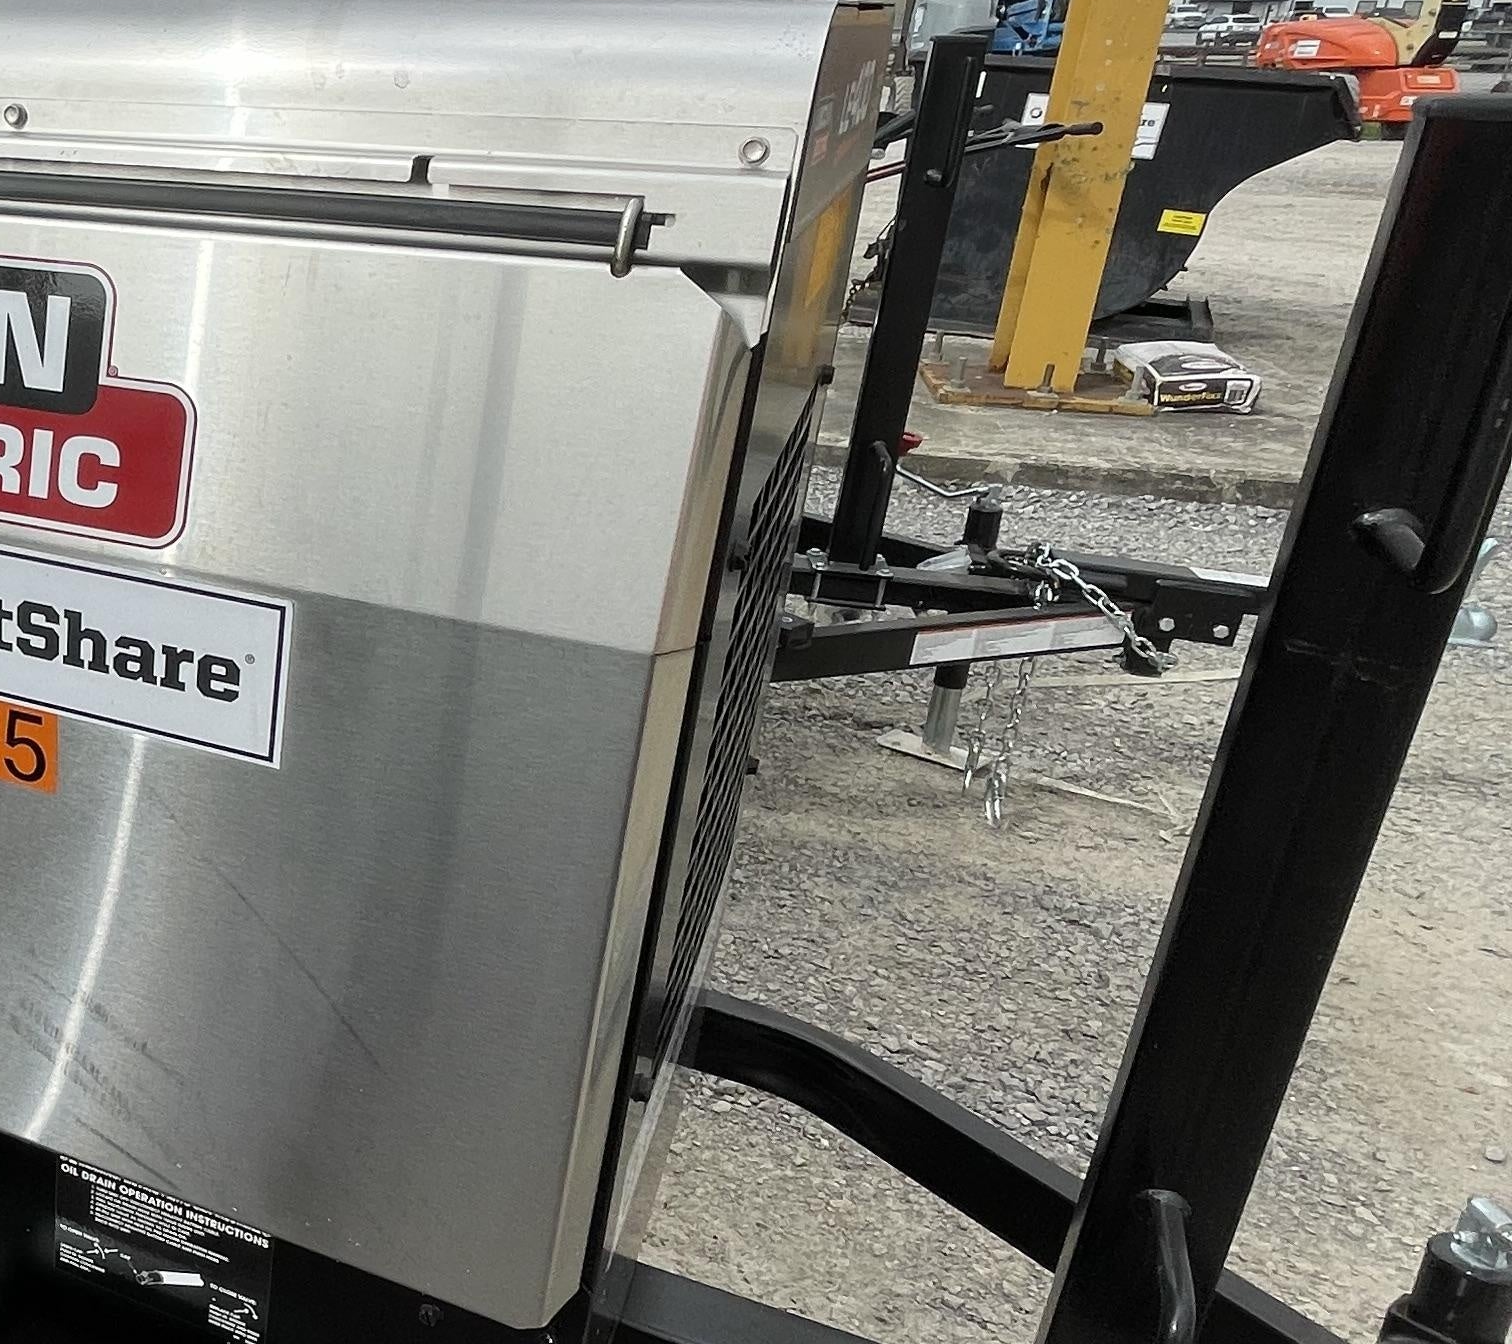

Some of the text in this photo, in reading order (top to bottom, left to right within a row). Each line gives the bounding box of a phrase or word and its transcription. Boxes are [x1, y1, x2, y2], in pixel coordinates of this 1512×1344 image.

[60, 1163, 79, 1177] OIL
[81, 1170, 117, 1191] DRAIN
[118, 1184, 183, 1216] OPERATION
[185, 1209, 269, 1250] INSTRUCTIONS
